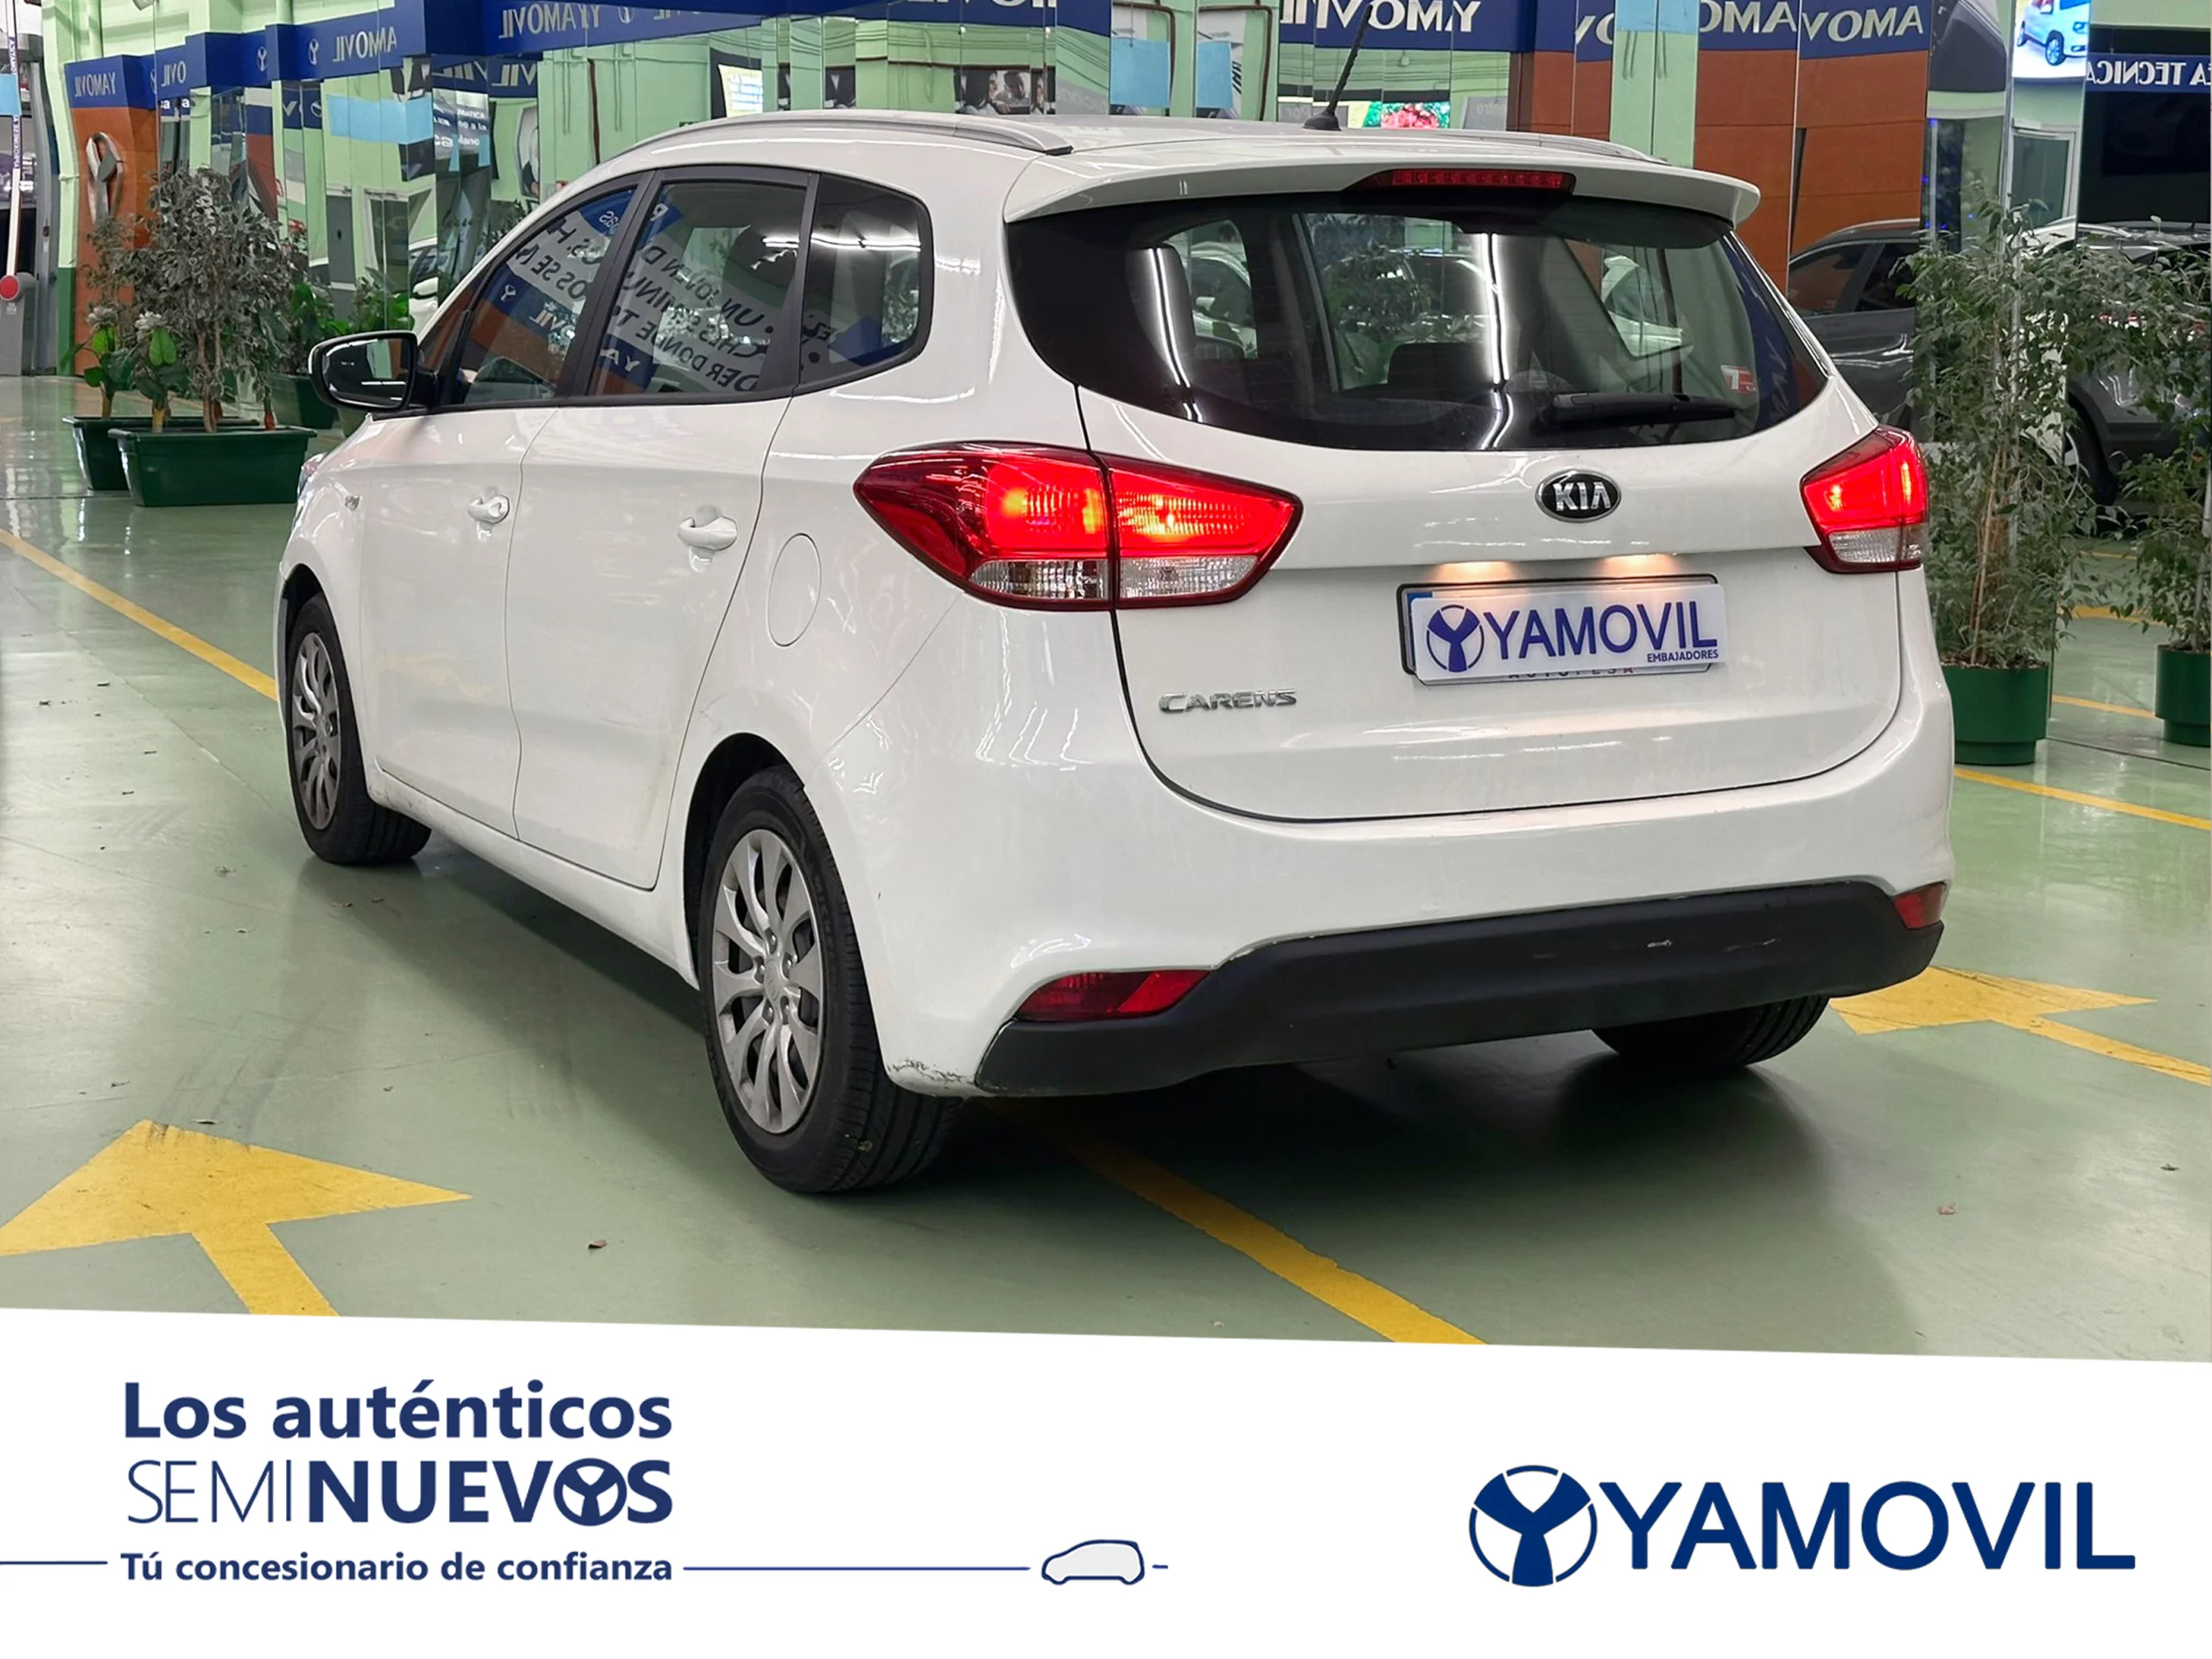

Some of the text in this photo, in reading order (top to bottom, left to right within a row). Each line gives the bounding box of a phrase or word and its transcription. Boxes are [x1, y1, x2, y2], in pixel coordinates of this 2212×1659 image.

[1553, 481, 1611, 512] KIA
[1483, 600, 1719, 661] YAMOVIL
[1646, 648, 1719, 664] EMBAJADORES
[1159, 688, 1298, 715] CARENS
